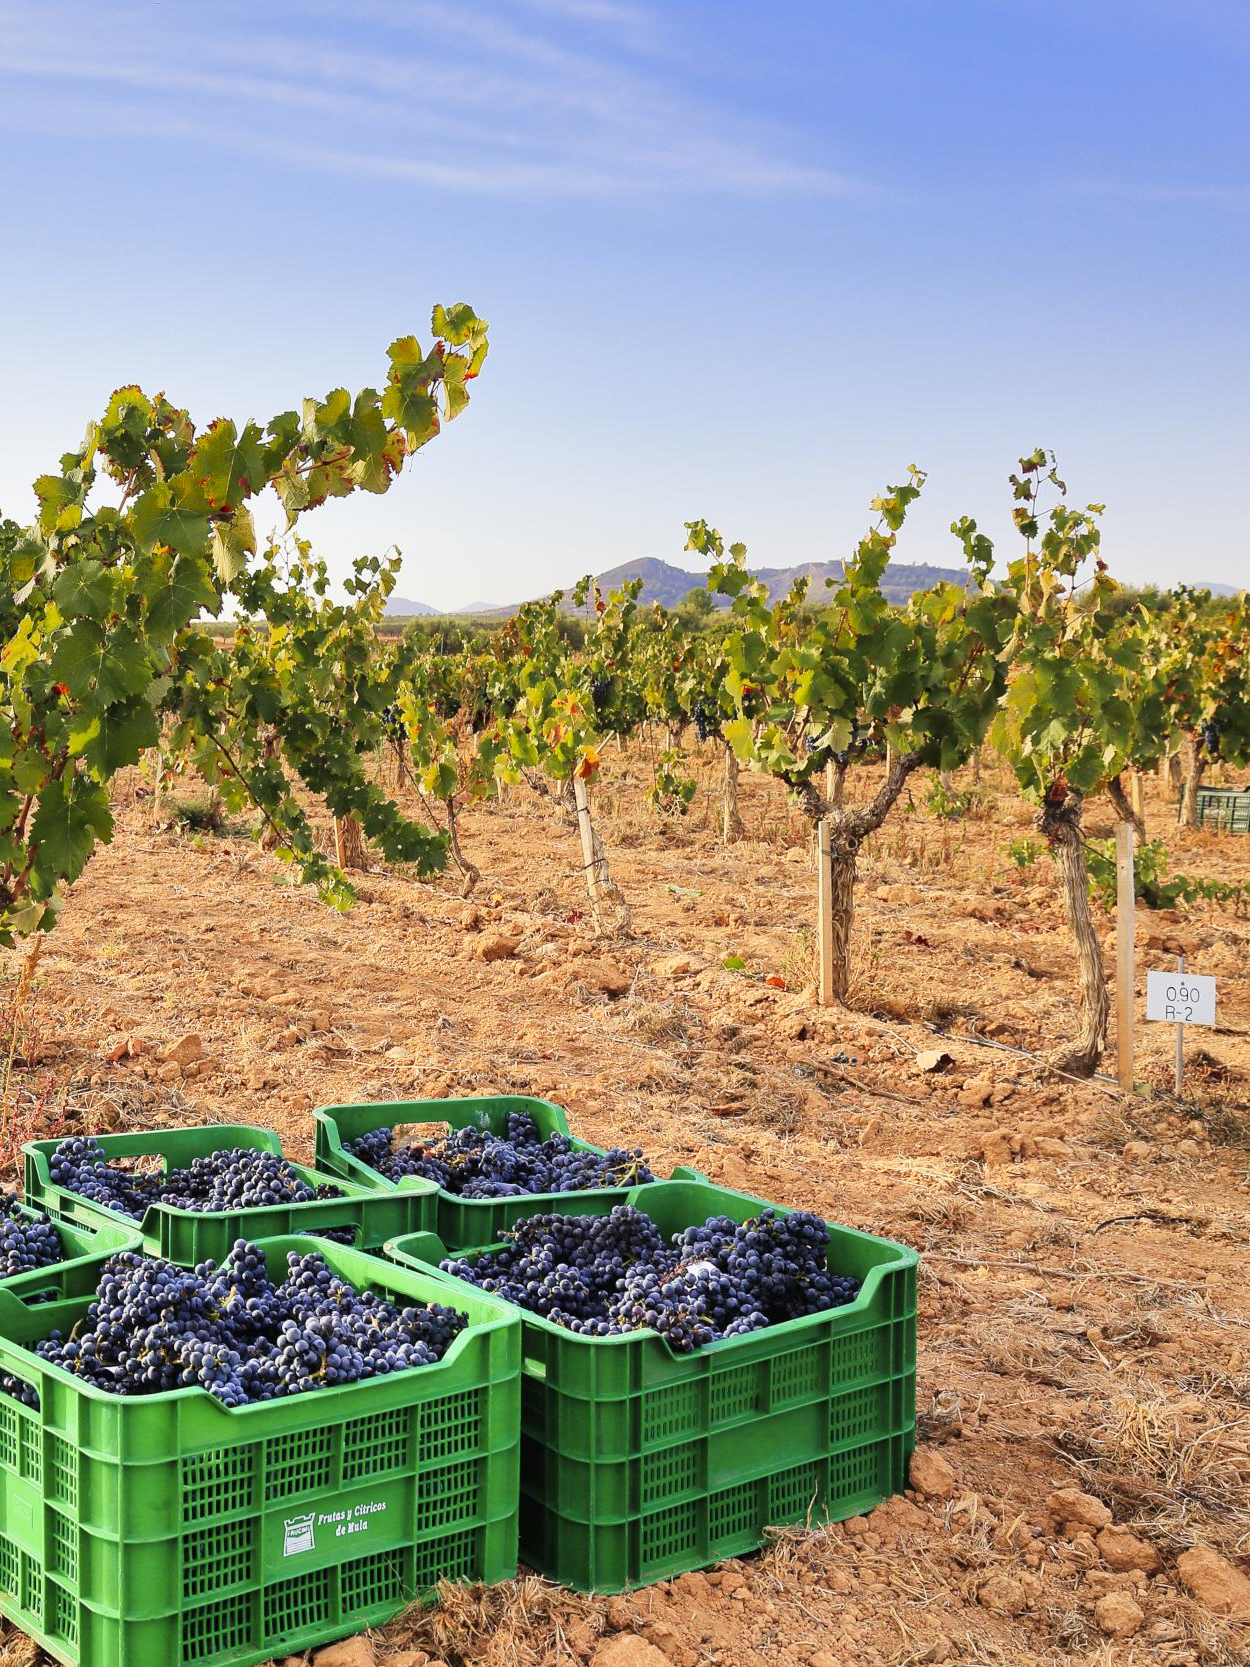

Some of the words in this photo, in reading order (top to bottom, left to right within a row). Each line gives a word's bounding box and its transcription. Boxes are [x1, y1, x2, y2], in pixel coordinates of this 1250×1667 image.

[1166, 986, 1200, 1003] 0.90
[1166, 1005, 1193, 1021] R-2
[318, 1511, 345, 1524] Frutas
[347, 1509, 352, 1520] y
[335, 1524, 346, 1536] de
[348, 1520, 368, 1533] Mula
